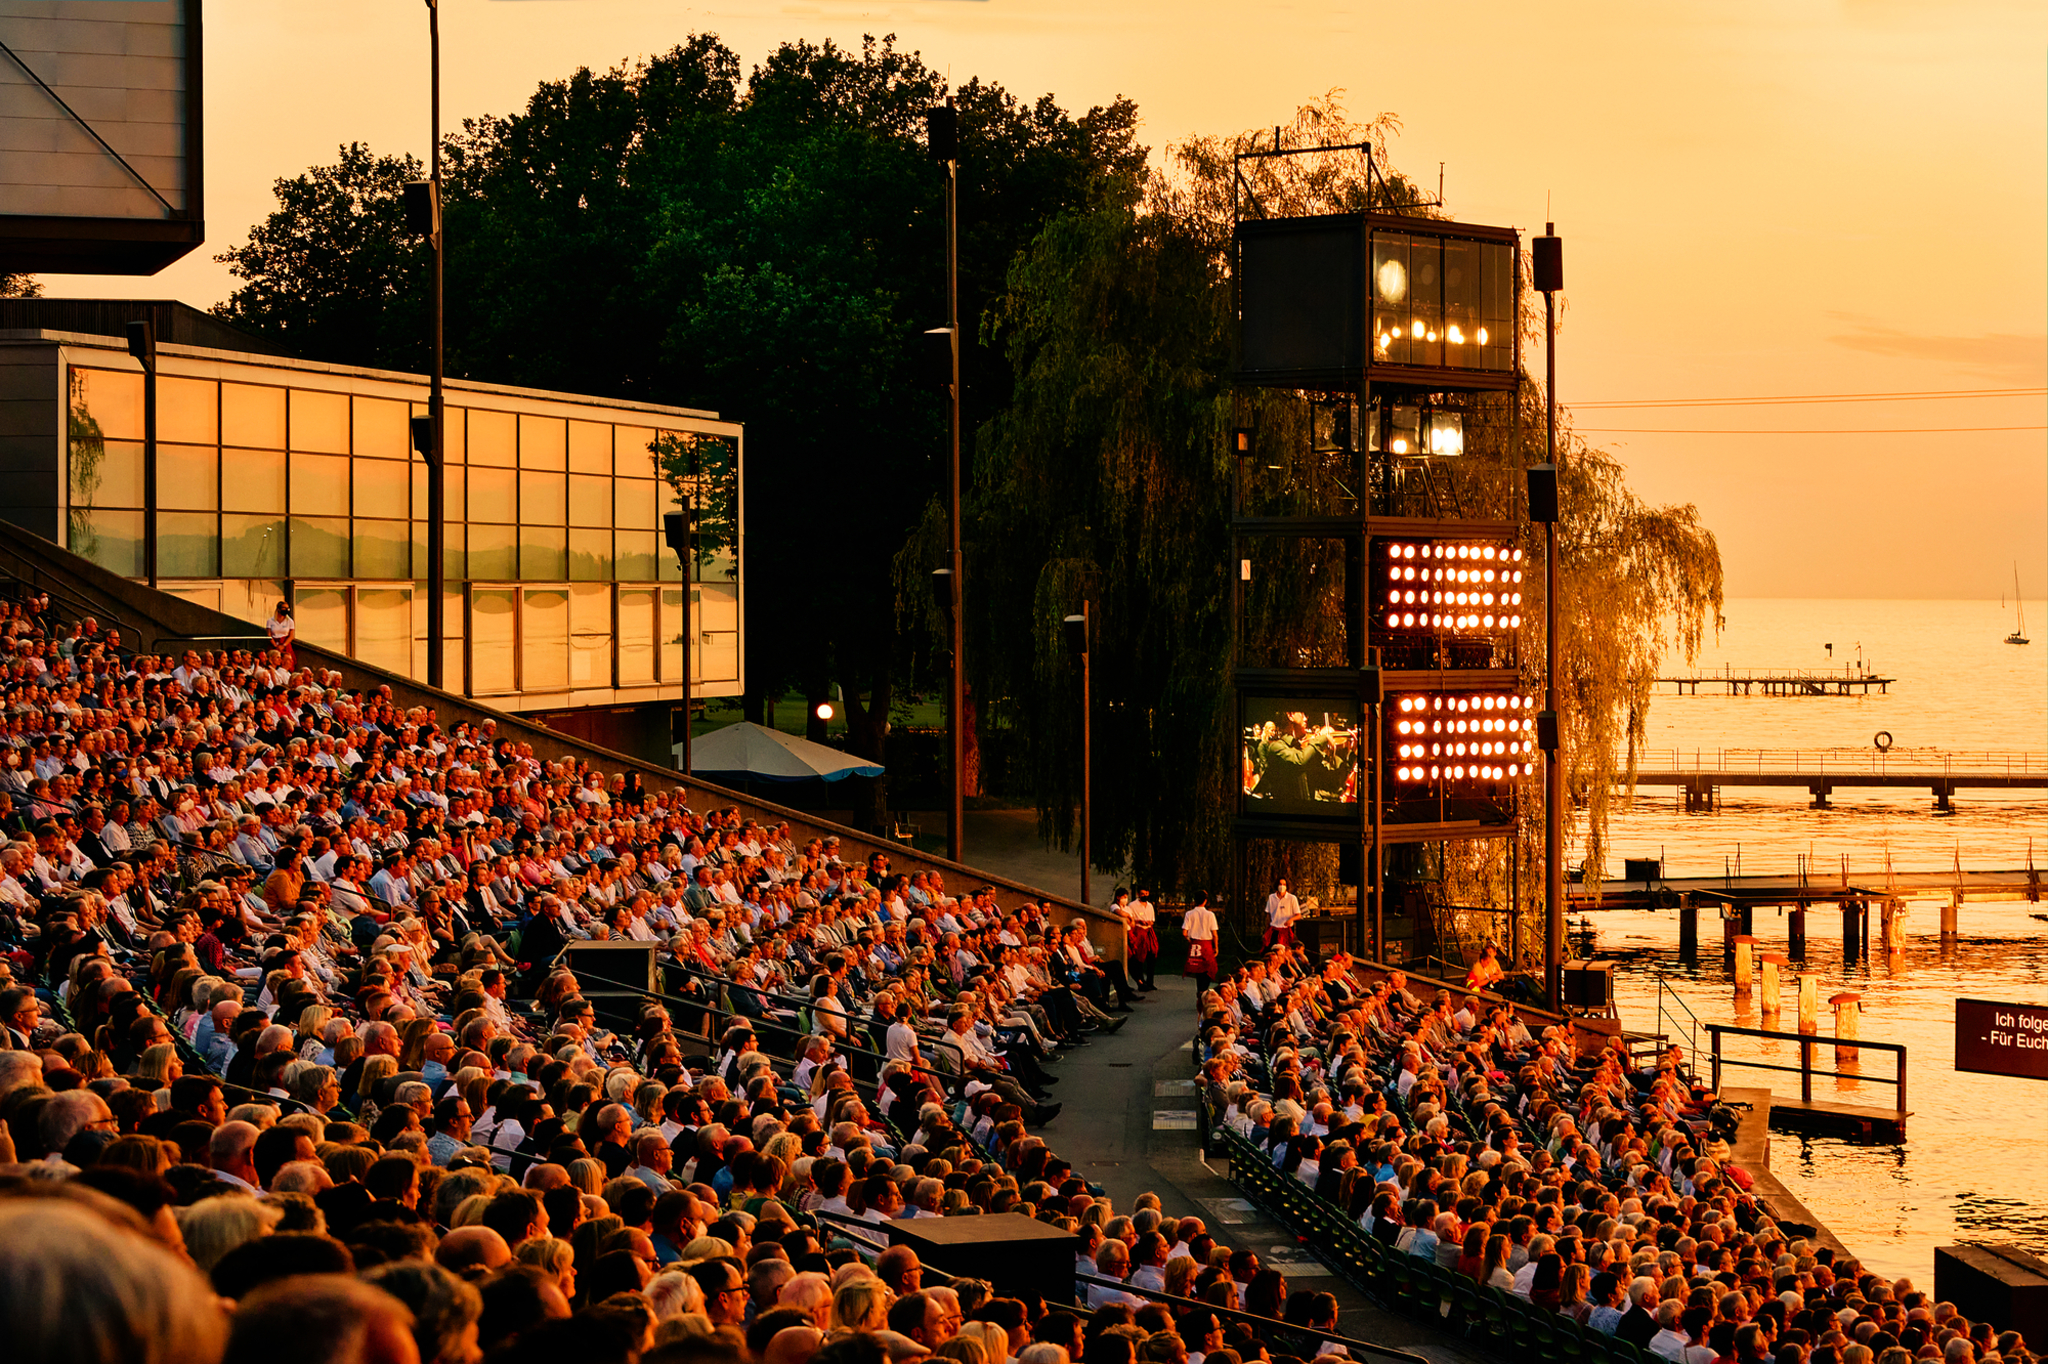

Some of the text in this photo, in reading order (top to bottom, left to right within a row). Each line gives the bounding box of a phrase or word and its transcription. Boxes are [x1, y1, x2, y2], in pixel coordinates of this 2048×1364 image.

[1190, 944, 1202, 957] B
[1995, 1011, 2048, 1034] Ich folge
[1990, 1030, 2014, 1047] Für
[2016, 1032, 2048, 1050] Euch
